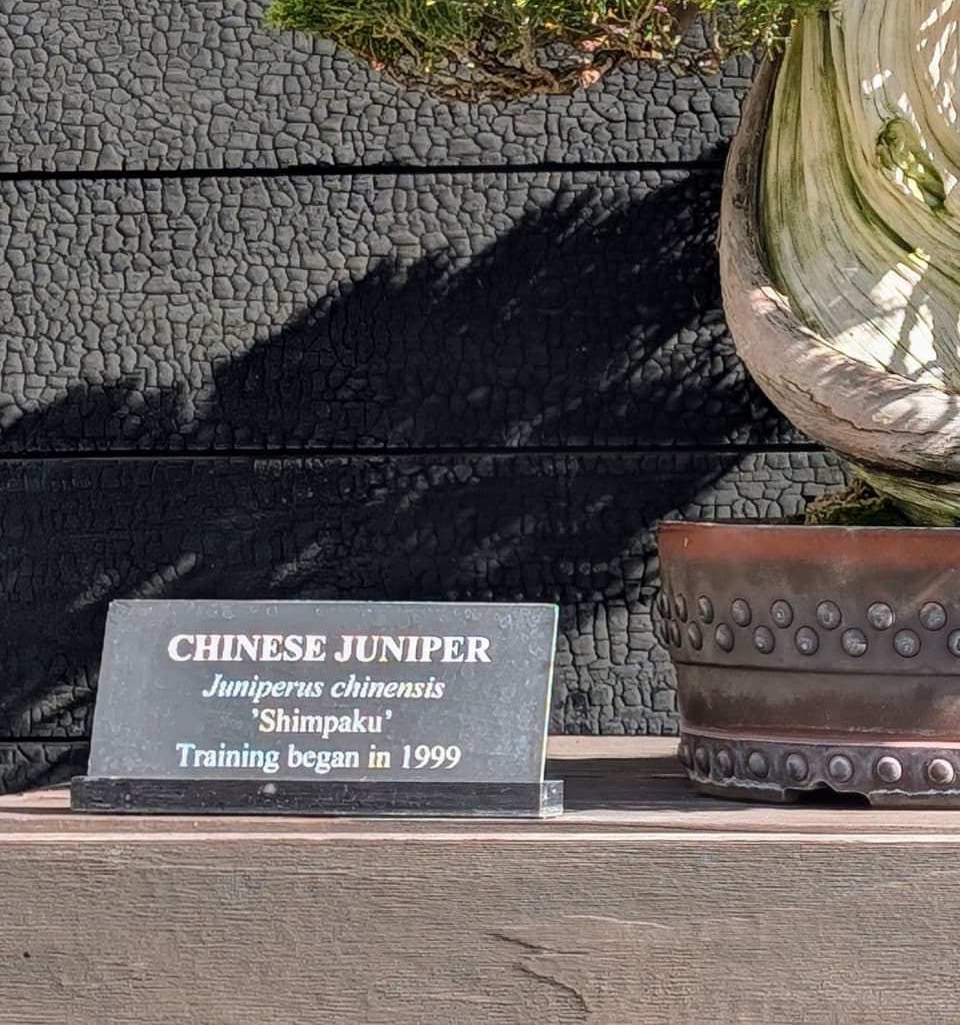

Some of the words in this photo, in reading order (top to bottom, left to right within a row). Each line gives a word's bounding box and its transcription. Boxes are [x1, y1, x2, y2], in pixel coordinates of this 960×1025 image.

[167, 633, 327, 662] CHINESE
[334, 634, 492, 663] JUNIPER
[202, 673, 323, 703] Juniperus
[330, 675, 445, 699] chinensis
[175, 743, 281, 773] Training
[287, 744, 359, 774] began
[368, 745, 391, 769] in
[401, 745, 462, 770] 1999
